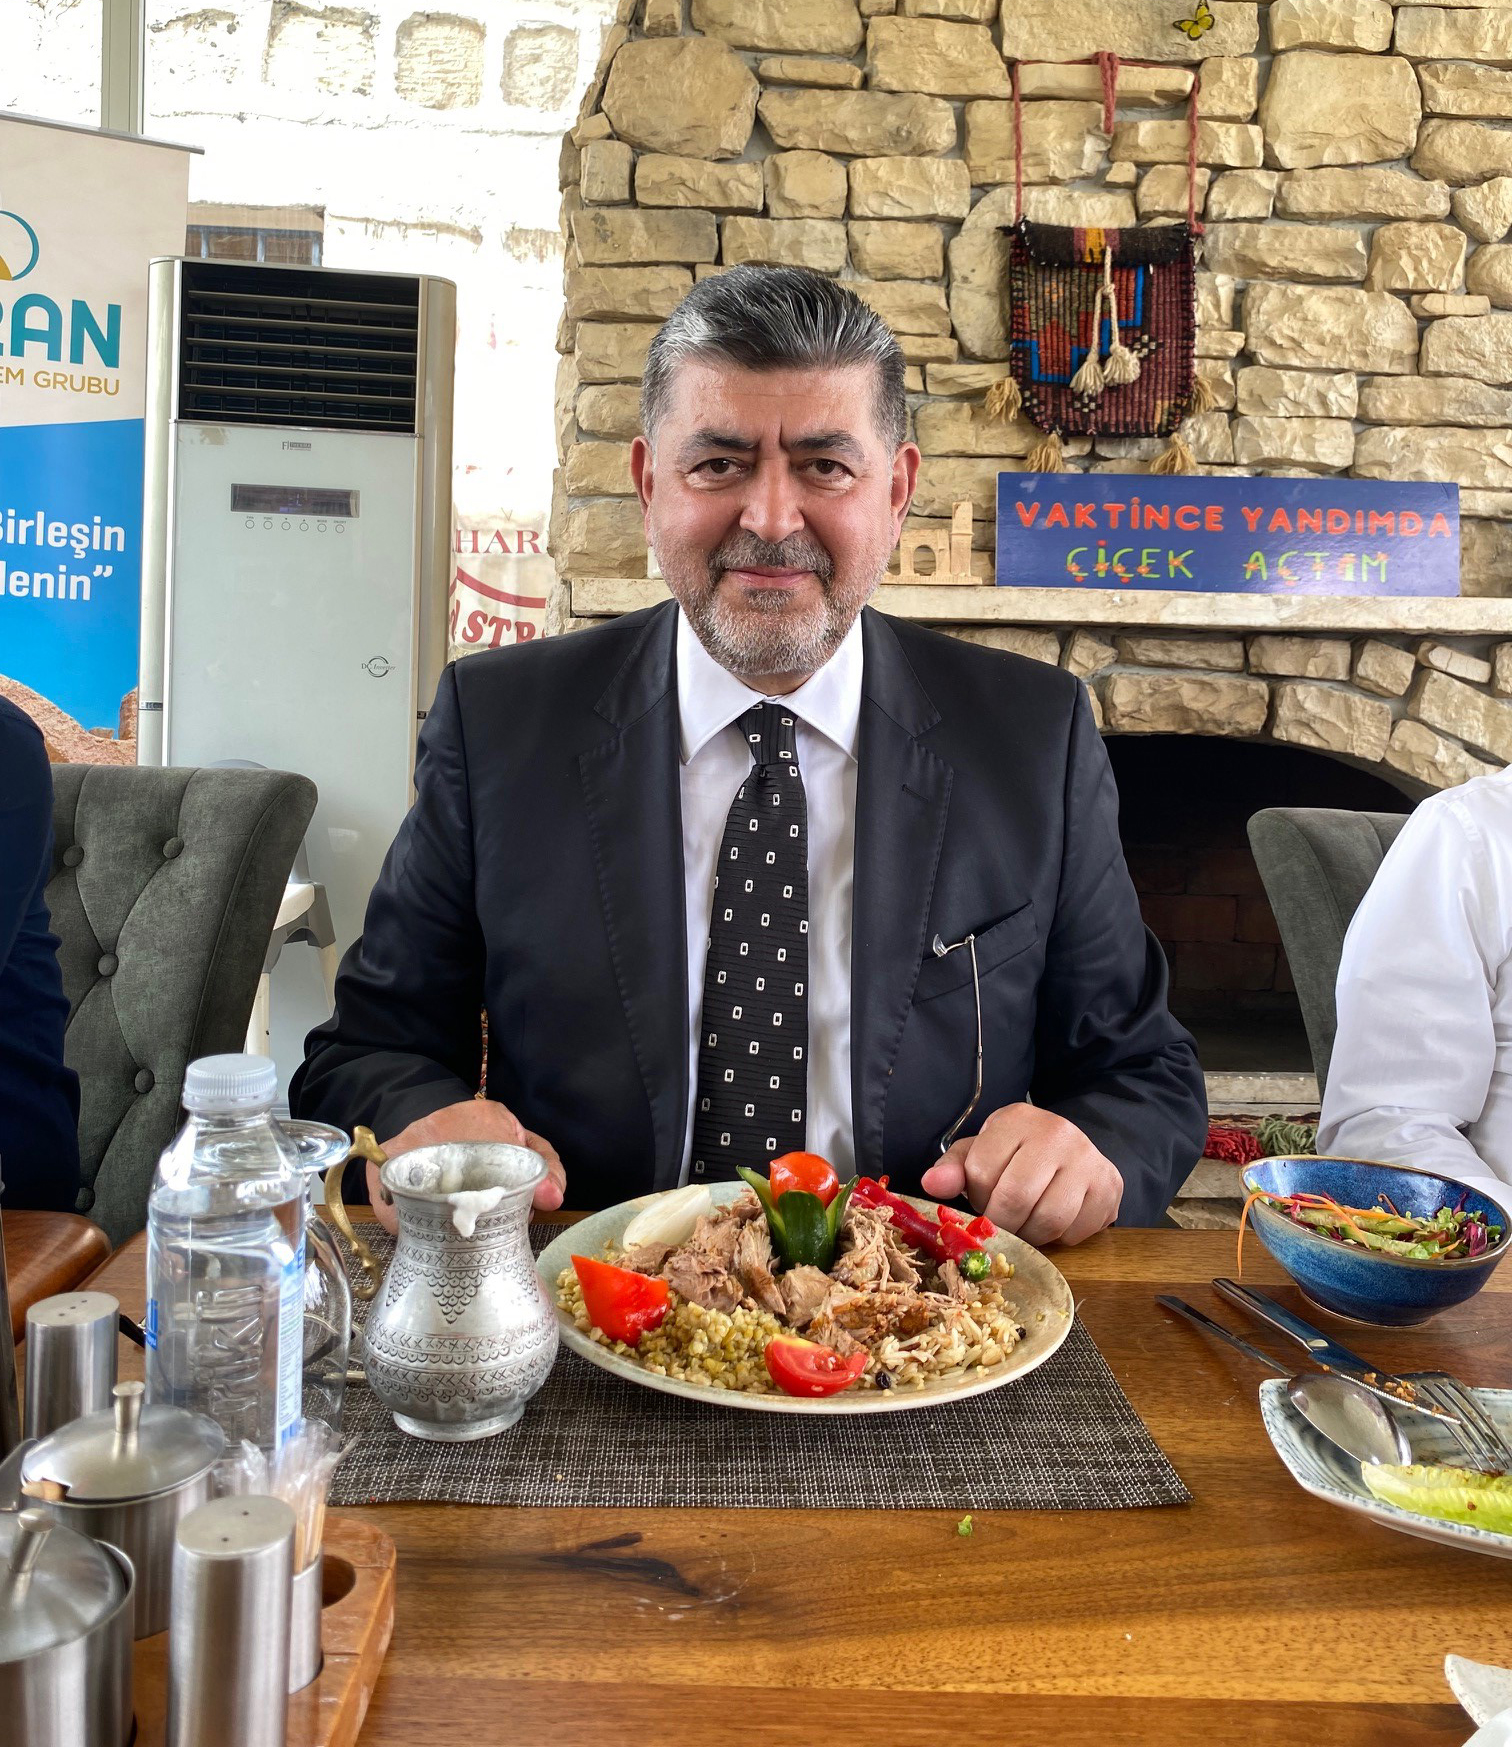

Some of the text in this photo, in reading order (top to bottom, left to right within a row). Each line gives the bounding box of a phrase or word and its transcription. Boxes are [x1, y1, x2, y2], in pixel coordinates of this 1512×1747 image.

[0, 293, 122, 369] AN
[33, 370, 120, 396] GRUBU
[0, 508, 125, 559] irleşin
[1015, 497, 1452, 538] VAKTİNCE YANDIMDA
[455, 529, 549, 554] HAR
[1066, 539, 1194, 584] ÇİÇEK
